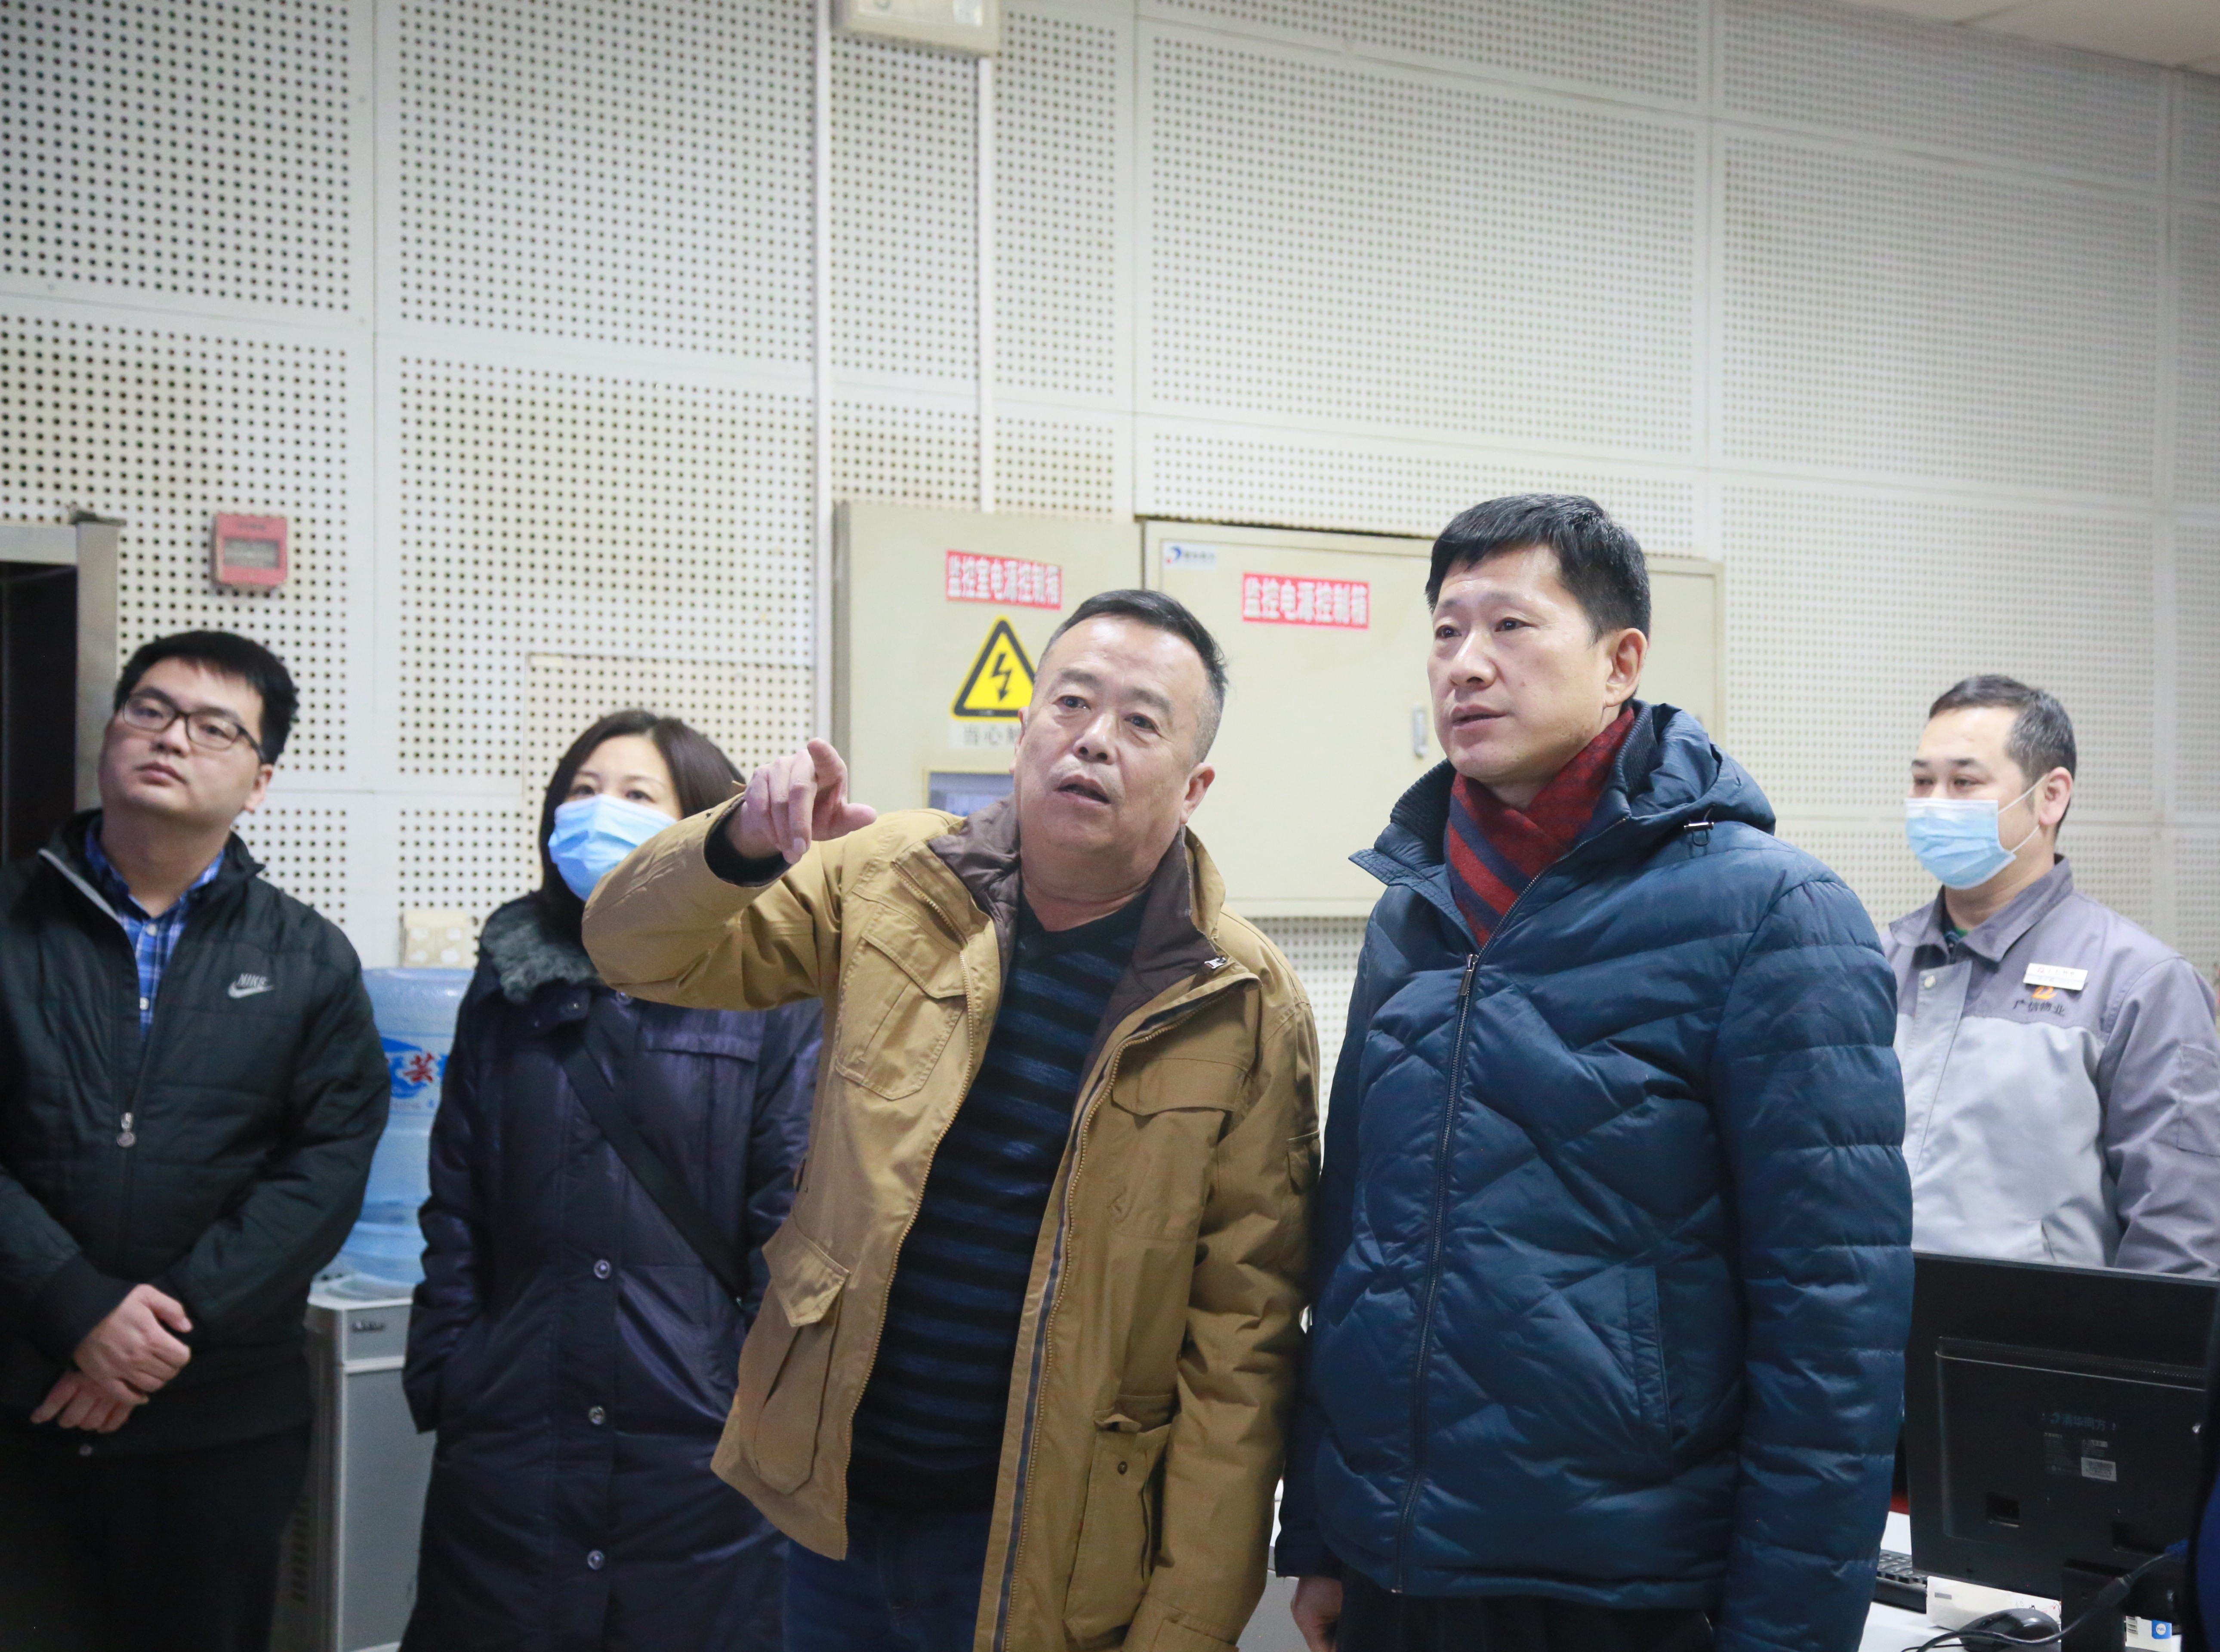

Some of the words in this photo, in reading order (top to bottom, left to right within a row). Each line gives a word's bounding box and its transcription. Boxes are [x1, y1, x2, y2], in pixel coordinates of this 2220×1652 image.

[1245, 576, 1368, 625] 监控电源控制箱
[237, 973, 268, 988] NIKE
[2013, 999, 2066, 1017] 广信物业
[2063, 1413, 2106, 1432] 清华同方
